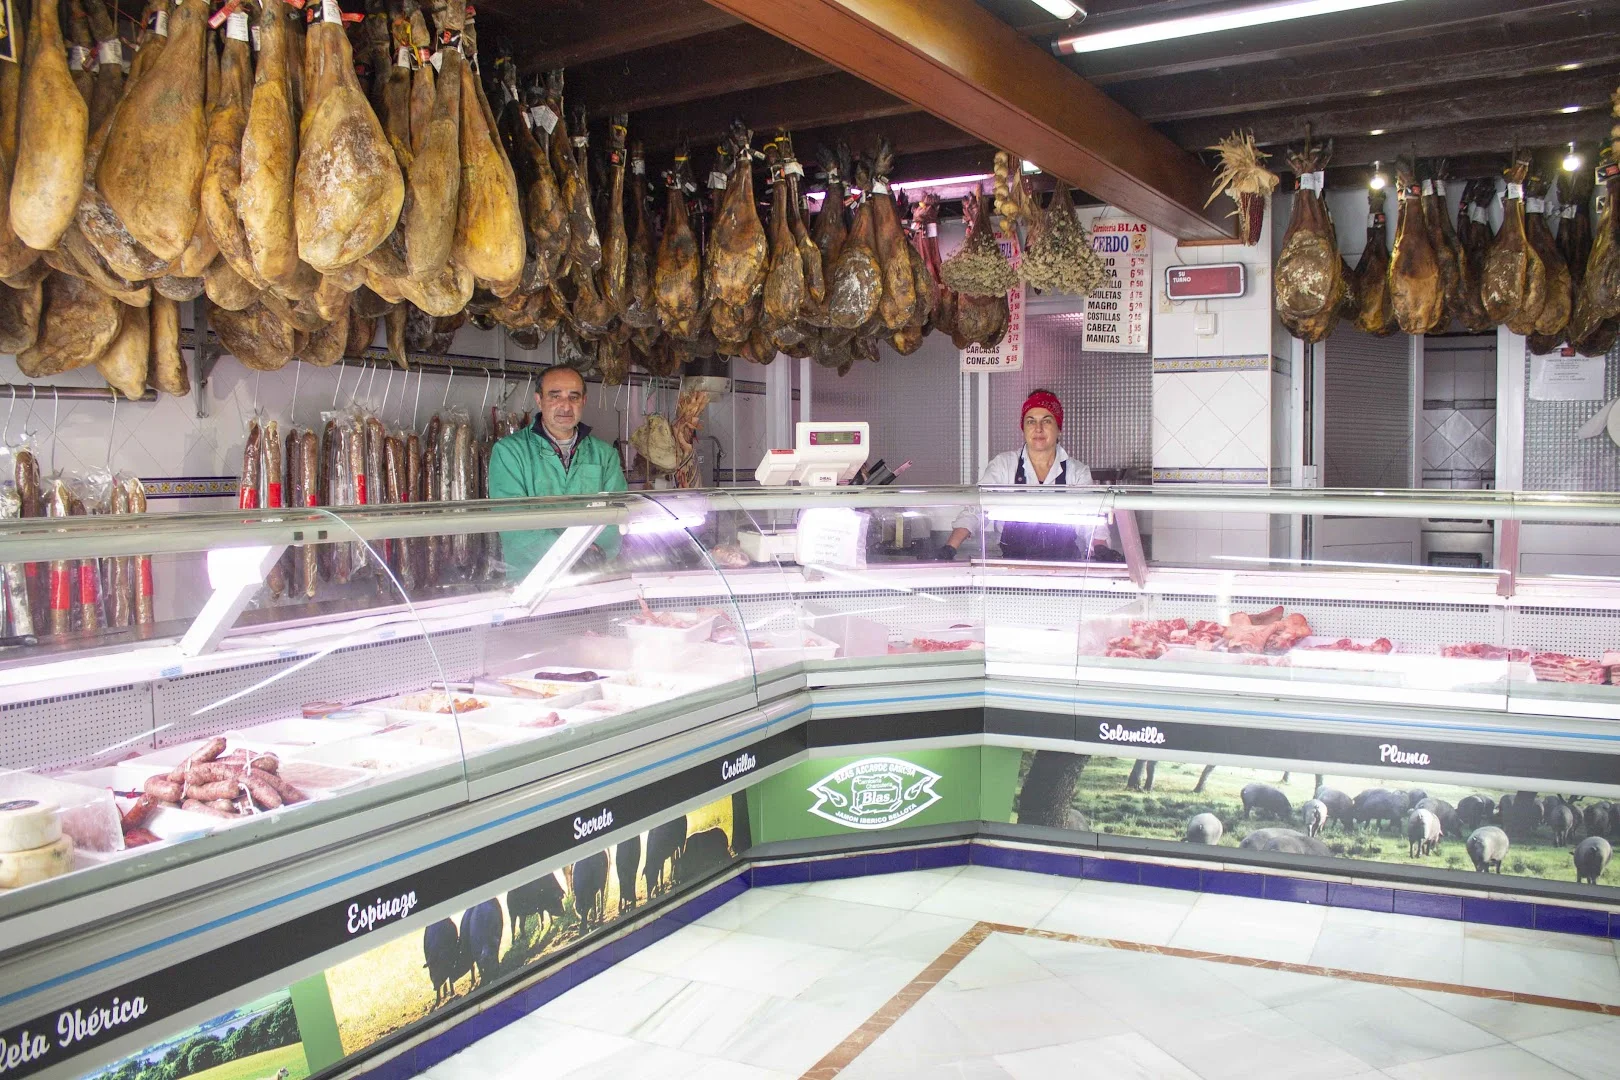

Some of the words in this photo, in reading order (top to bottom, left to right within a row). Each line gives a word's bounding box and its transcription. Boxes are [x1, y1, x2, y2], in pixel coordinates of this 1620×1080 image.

[1117, 223, 1147, 232] BLAS
[1093, 235, 1129, 253] CERDO
[1088, 302, 1117, 310] MAGRO
[1087, 312, 1120, 321] COSTILLAS
[1086, 323, 1116, 332] CABEZA
[1086, 334, 1120, 343] MANITAS
[1099, 722, 1166, 744] Solomillo
[1378, 744, 1430, 766] Pluma
[721, 753, 756, 780] Costillas
[862, 791, 890, 803] Blas
[888, 804, 918, 820] BELLOTA
[573, 808, 614, 840] Secreto
[347, 890, 418, 934] Espinazo
[57, 996, 148, 1047] Ibérica
